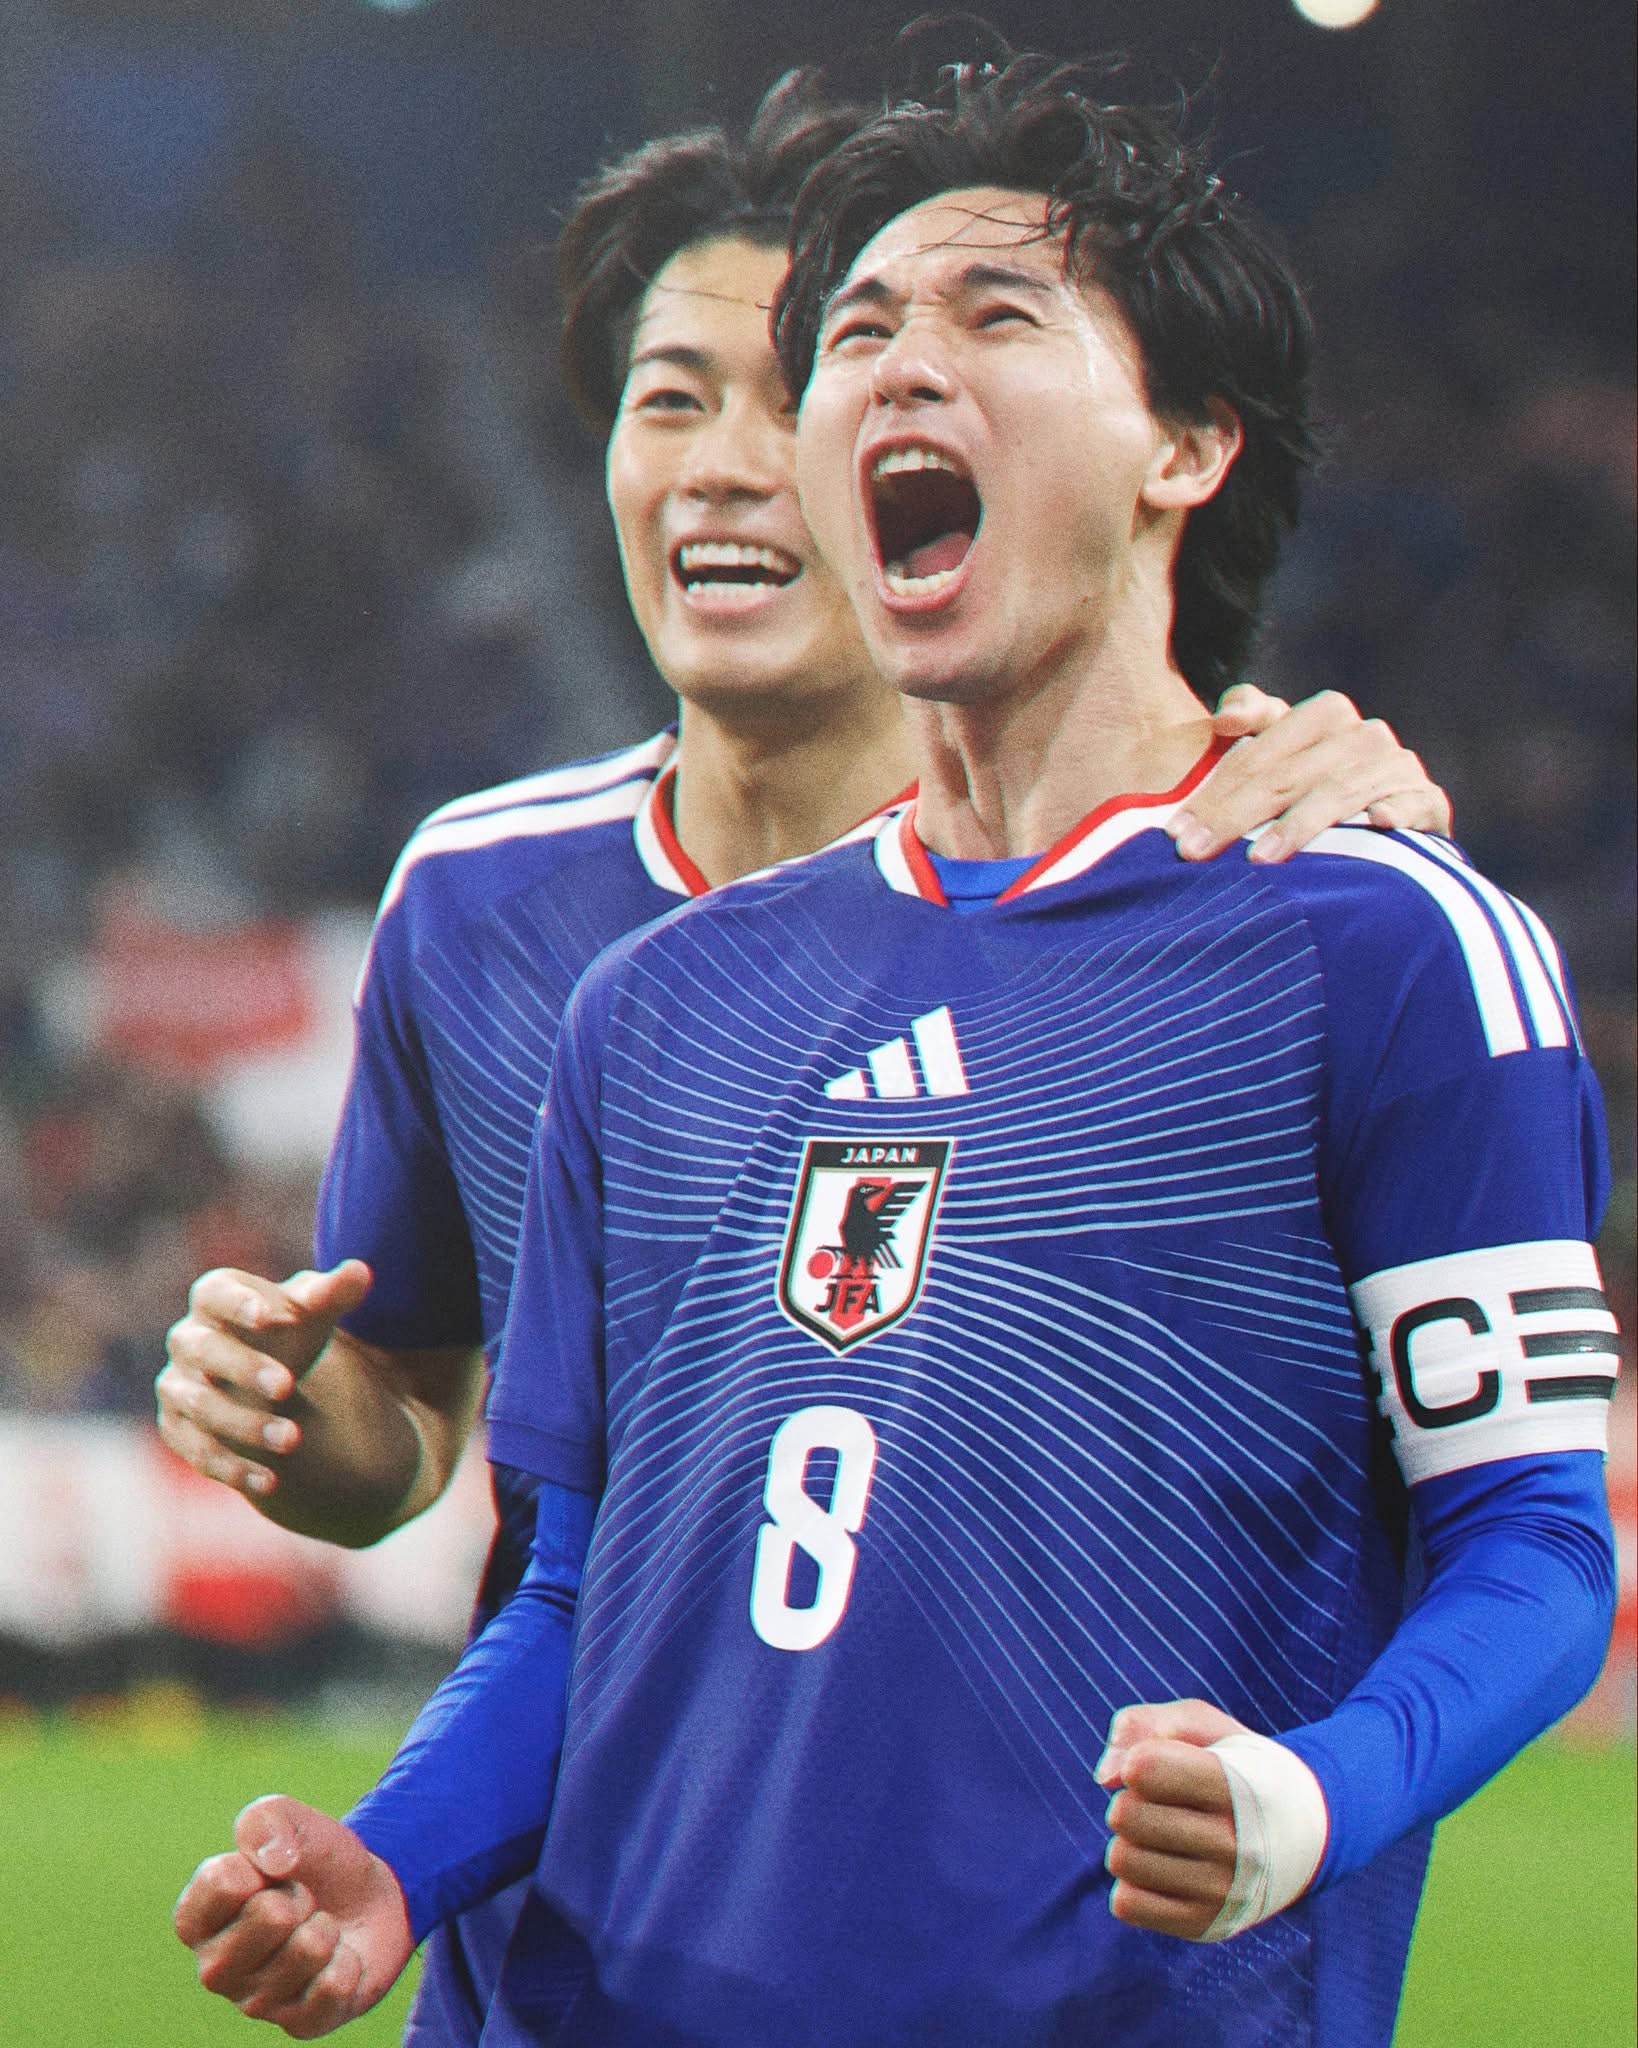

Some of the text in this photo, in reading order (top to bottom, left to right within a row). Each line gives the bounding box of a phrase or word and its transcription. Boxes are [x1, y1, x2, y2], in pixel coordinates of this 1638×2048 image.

[841, 1146, 918, 1164] JAPAN
[814, 1282, 883, 1314] JFA
[1390, 1297, 1502, 1429] C
[750, 1405, 879, 1652] 8
